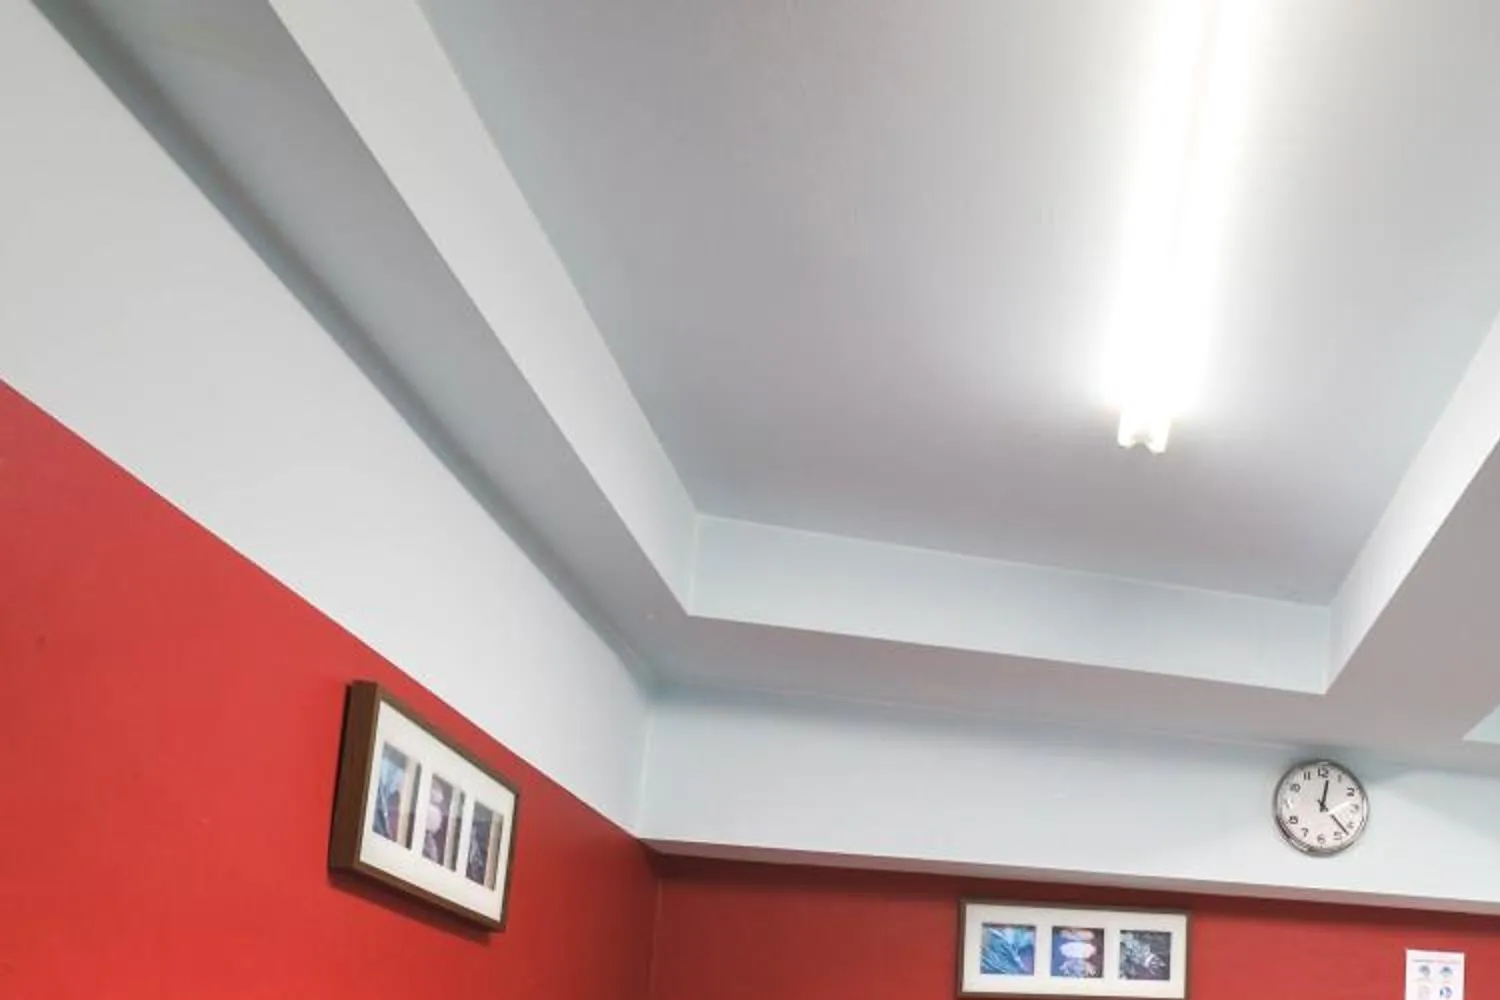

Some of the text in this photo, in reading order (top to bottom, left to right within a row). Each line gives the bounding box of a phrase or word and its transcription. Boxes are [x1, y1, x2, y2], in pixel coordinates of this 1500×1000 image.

[1303, 772, 1311, 780] 11
[1317, 767, 1329, 778] 12
[1347, 787, 1355, 797] 2
[1301, 827, 1309, 837] 7
[1317, 833, 1325, 844] 6
